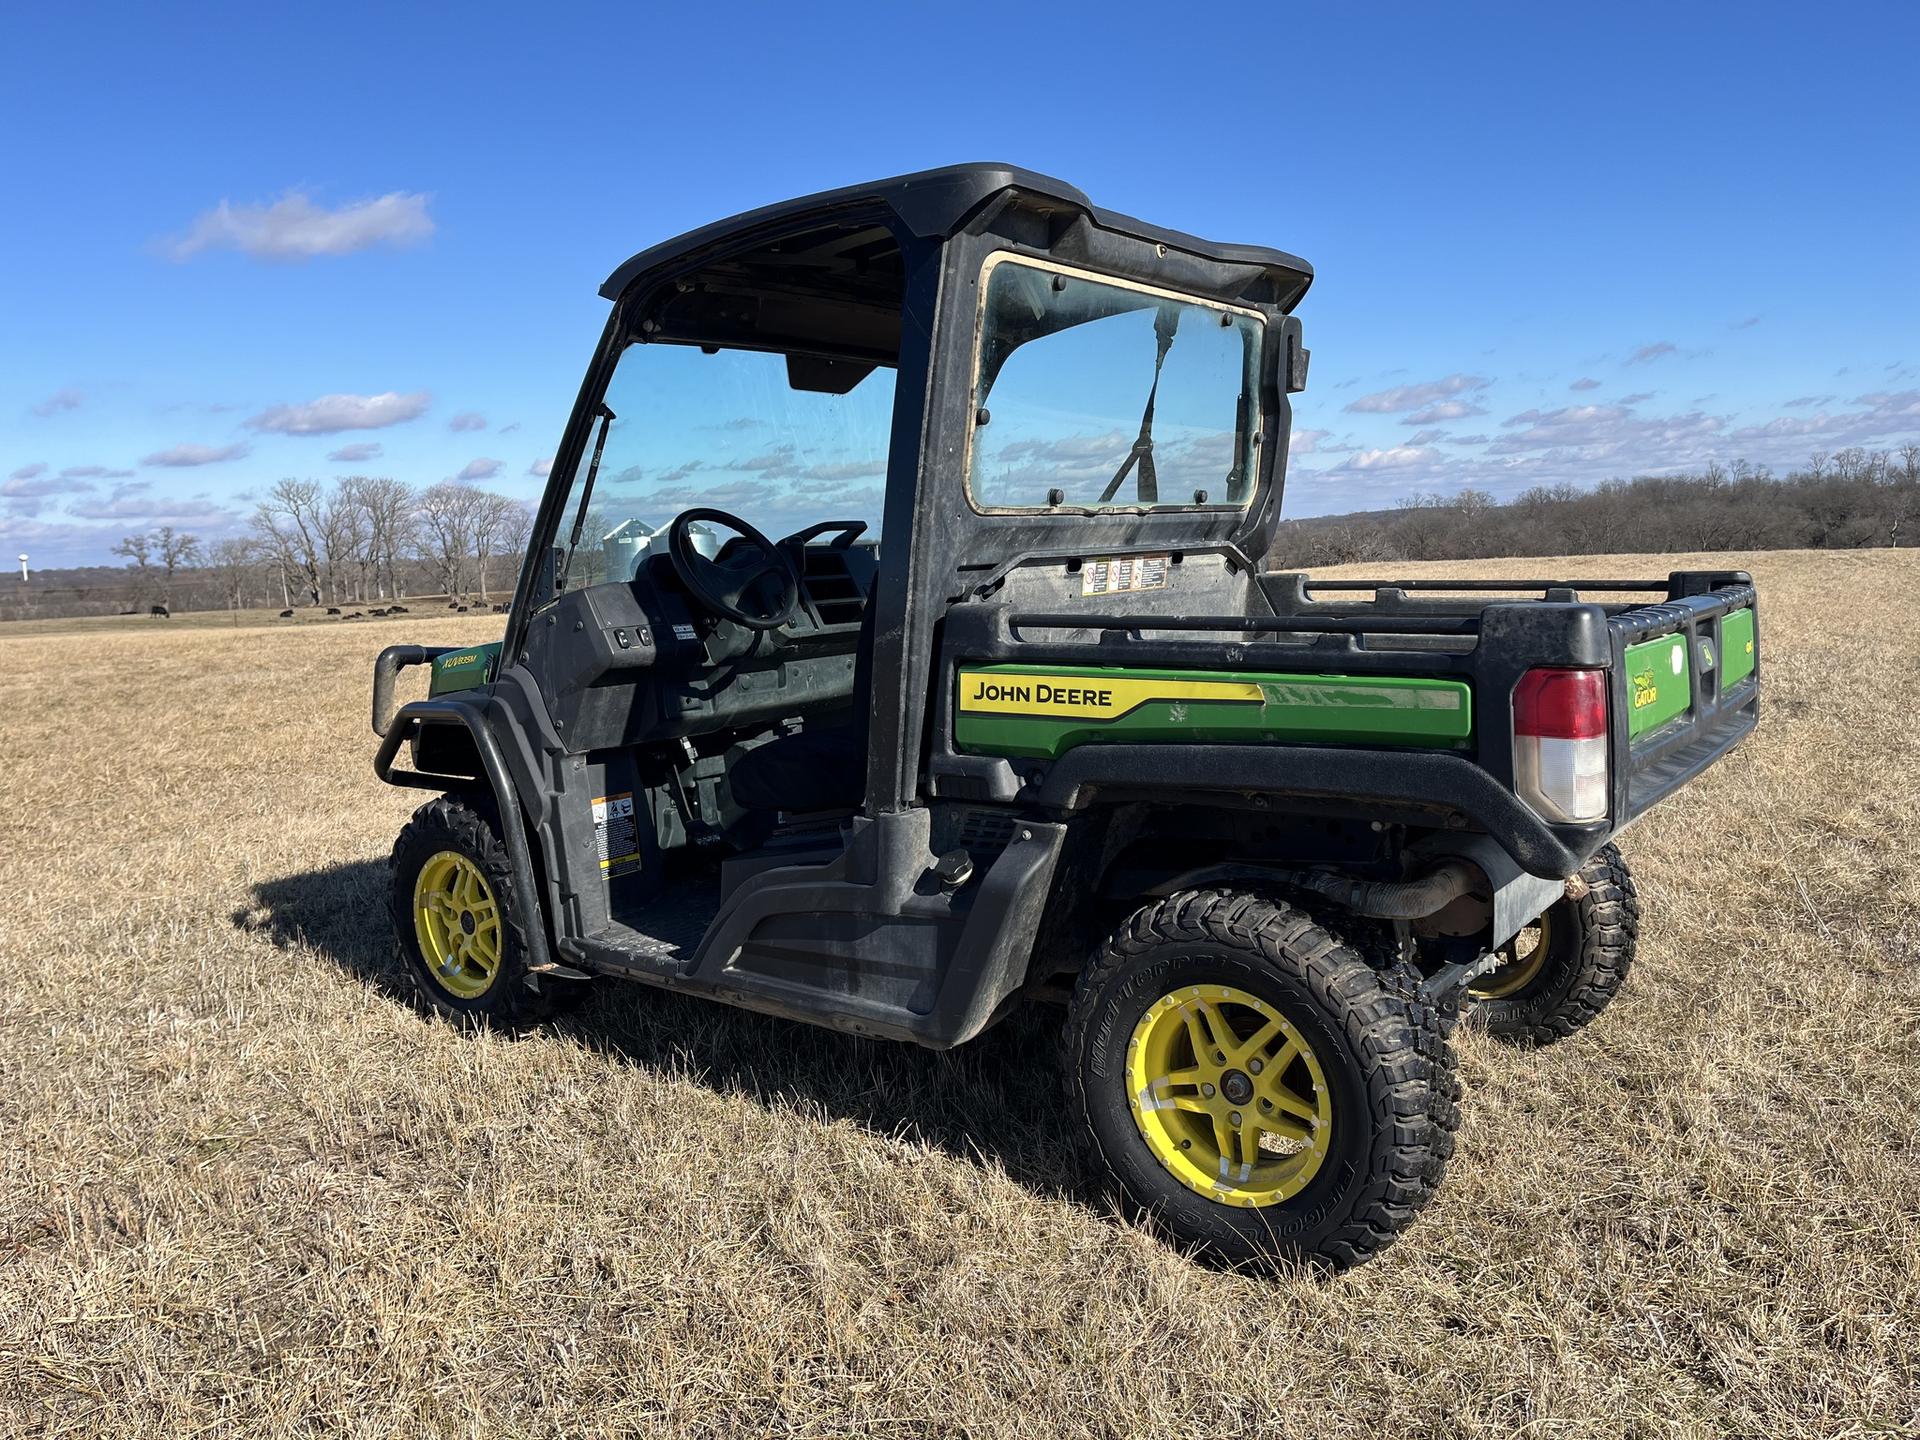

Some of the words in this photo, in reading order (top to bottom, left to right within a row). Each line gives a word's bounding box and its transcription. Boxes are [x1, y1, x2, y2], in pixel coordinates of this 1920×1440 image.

[973, 681, 1031, 703] JOHN
[1036, 683, 1113, 707] DEERE
[1634, 686, 1657, 709] GATOR
